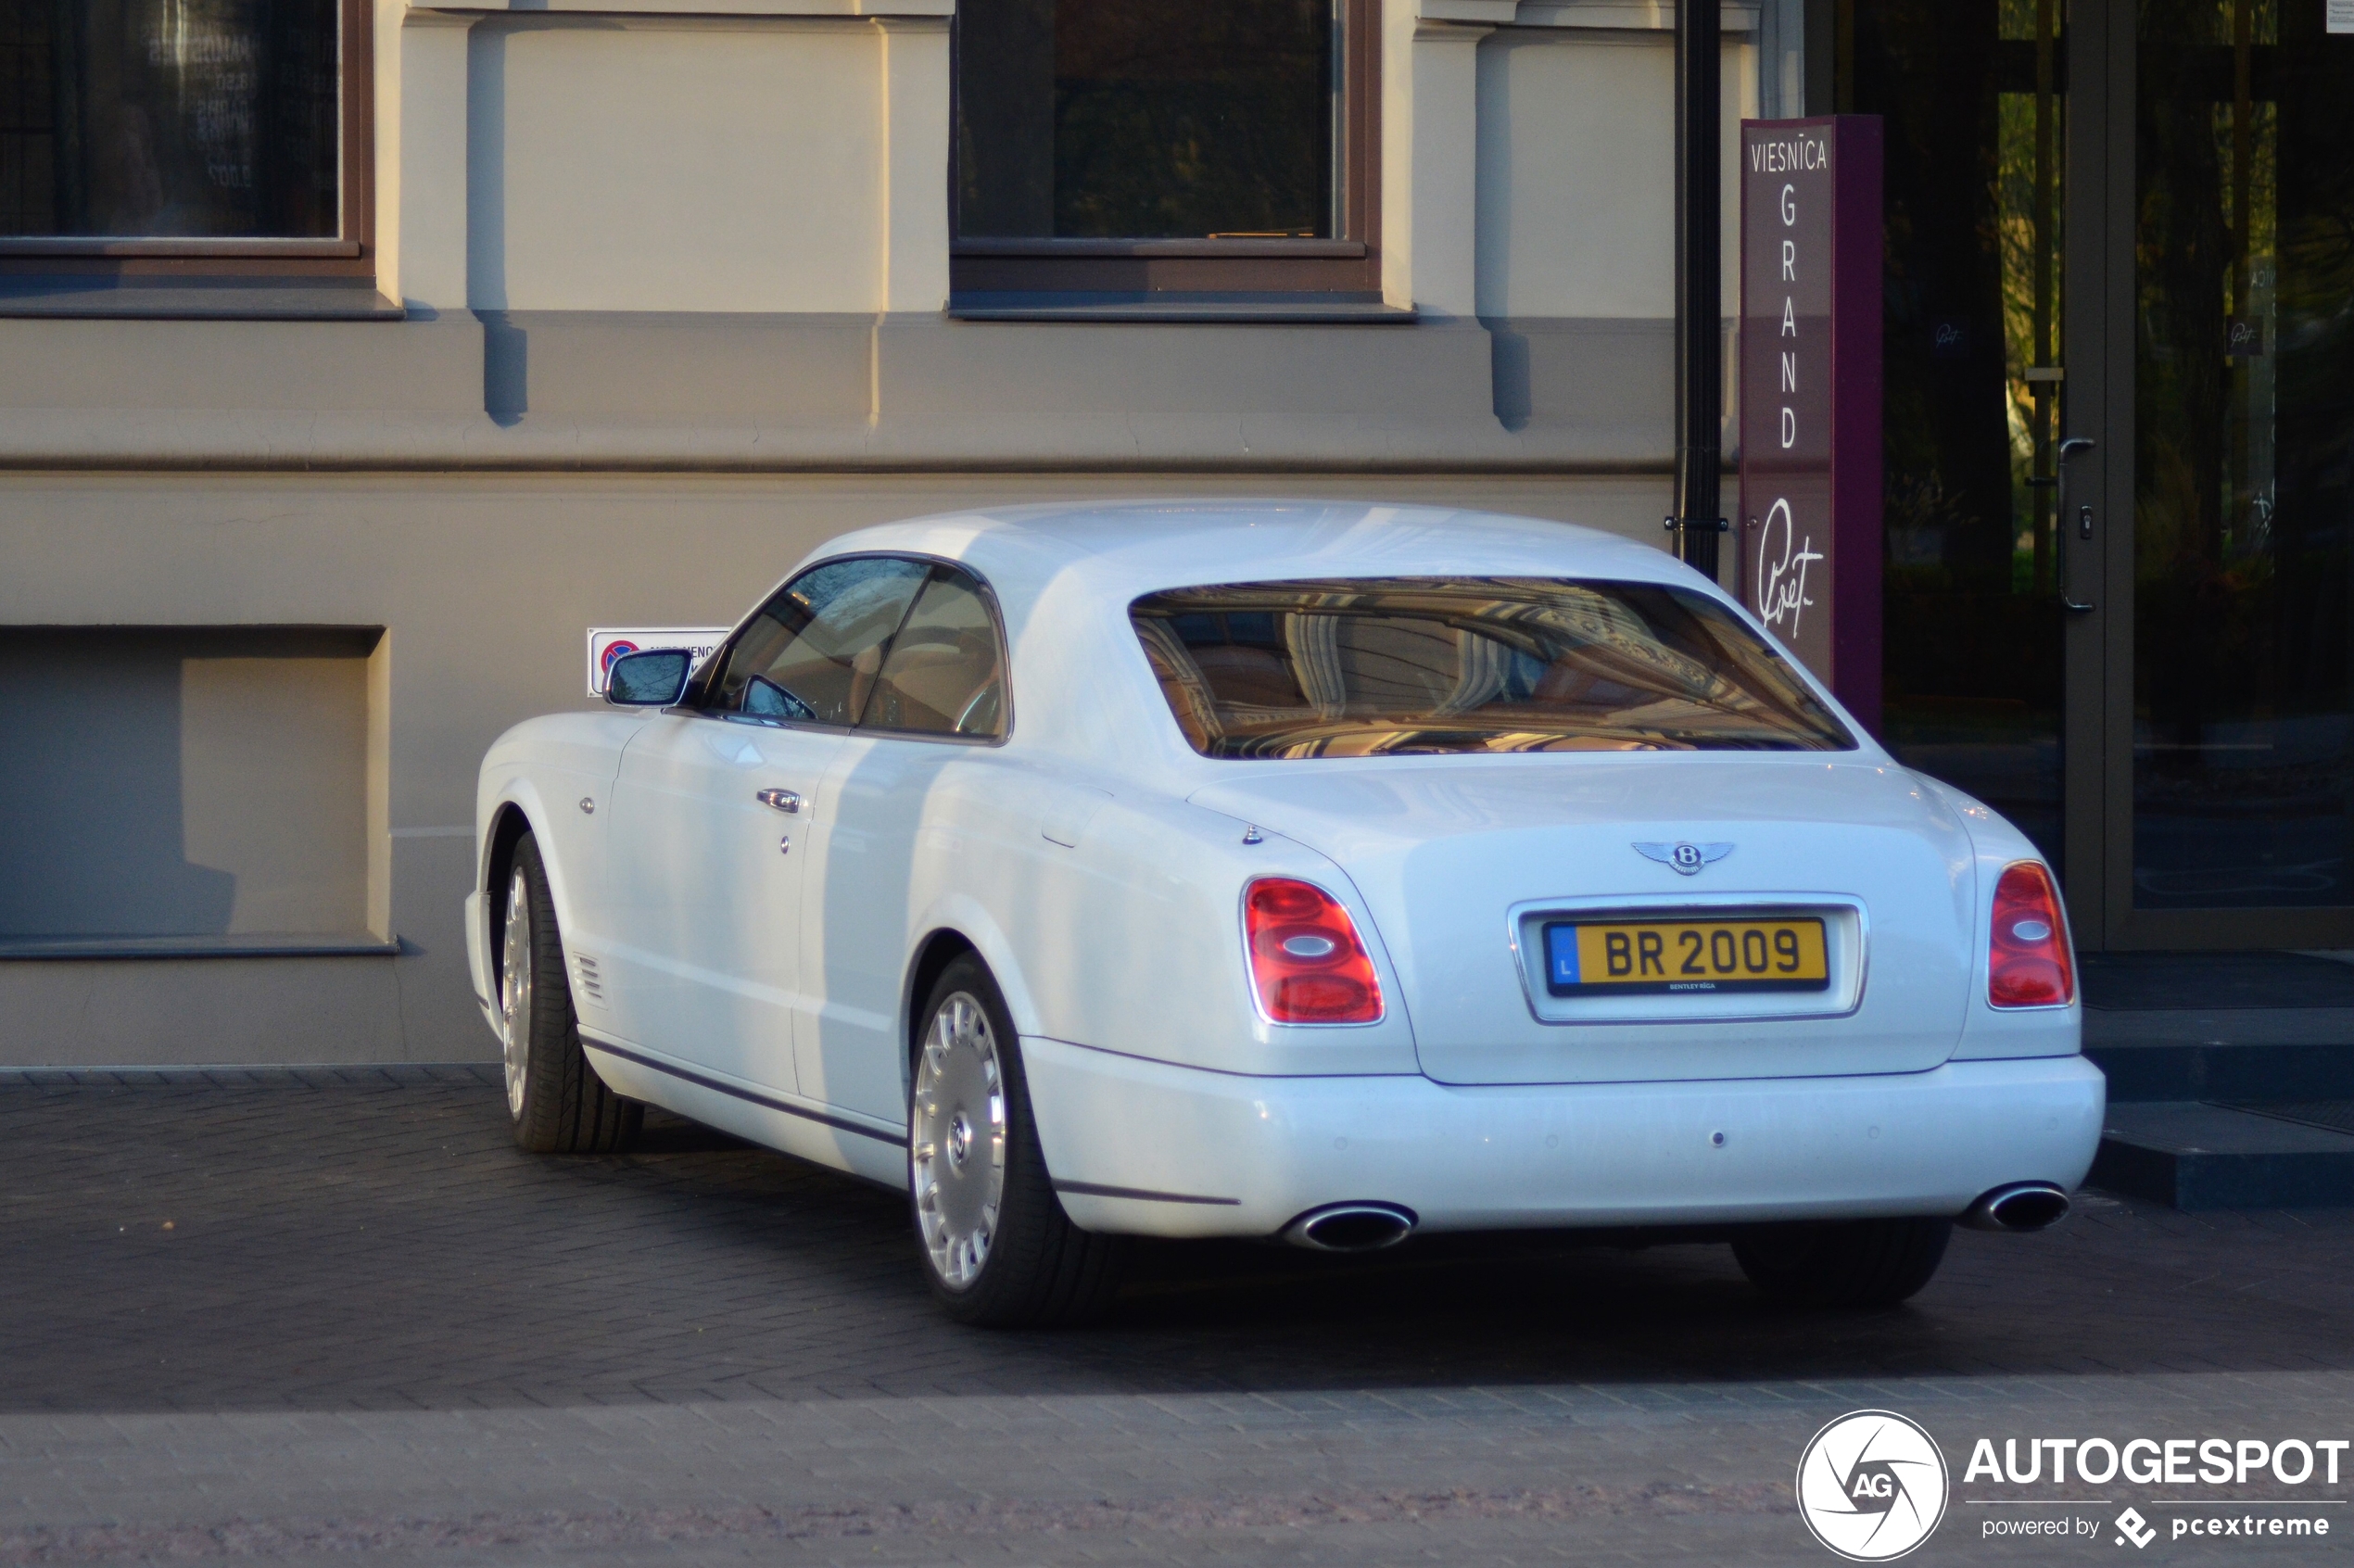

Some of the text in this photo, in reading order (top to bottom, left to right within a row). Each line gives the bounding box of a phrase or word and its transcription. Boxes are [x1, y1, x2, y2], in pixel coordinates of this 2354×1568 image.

[1752, 133, 1827, 172] VIESNĪCA
[1781, 183, 1796, 449] GRAND
[1758, 498, 1824, 639] Poet
[1677, 846, 1697, 865] B
[1561, 959, 1571, 976] L
[1605, 929, 1800, 977] BR 2009
